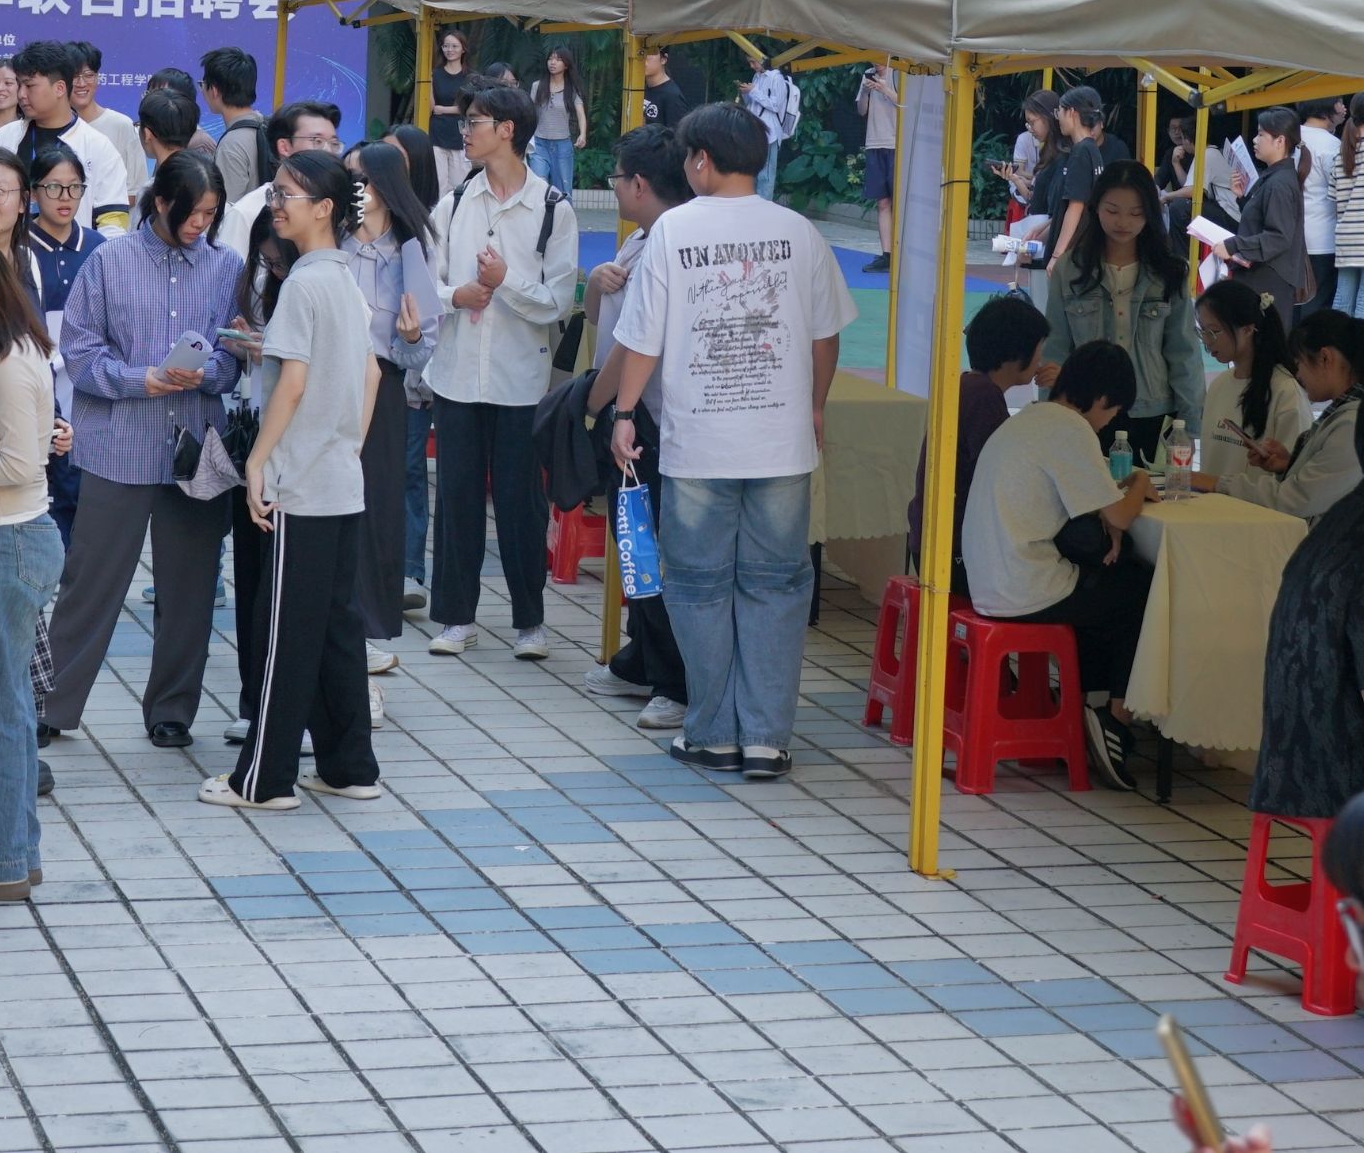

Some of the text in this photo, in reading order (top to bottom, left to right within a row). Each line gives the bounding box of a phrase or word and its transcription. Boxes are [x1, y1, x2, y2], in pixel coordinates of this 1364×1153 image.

[97, 72, 153, 87] 药工程学
[617, 493, 637, 596] Cotti Coffee
